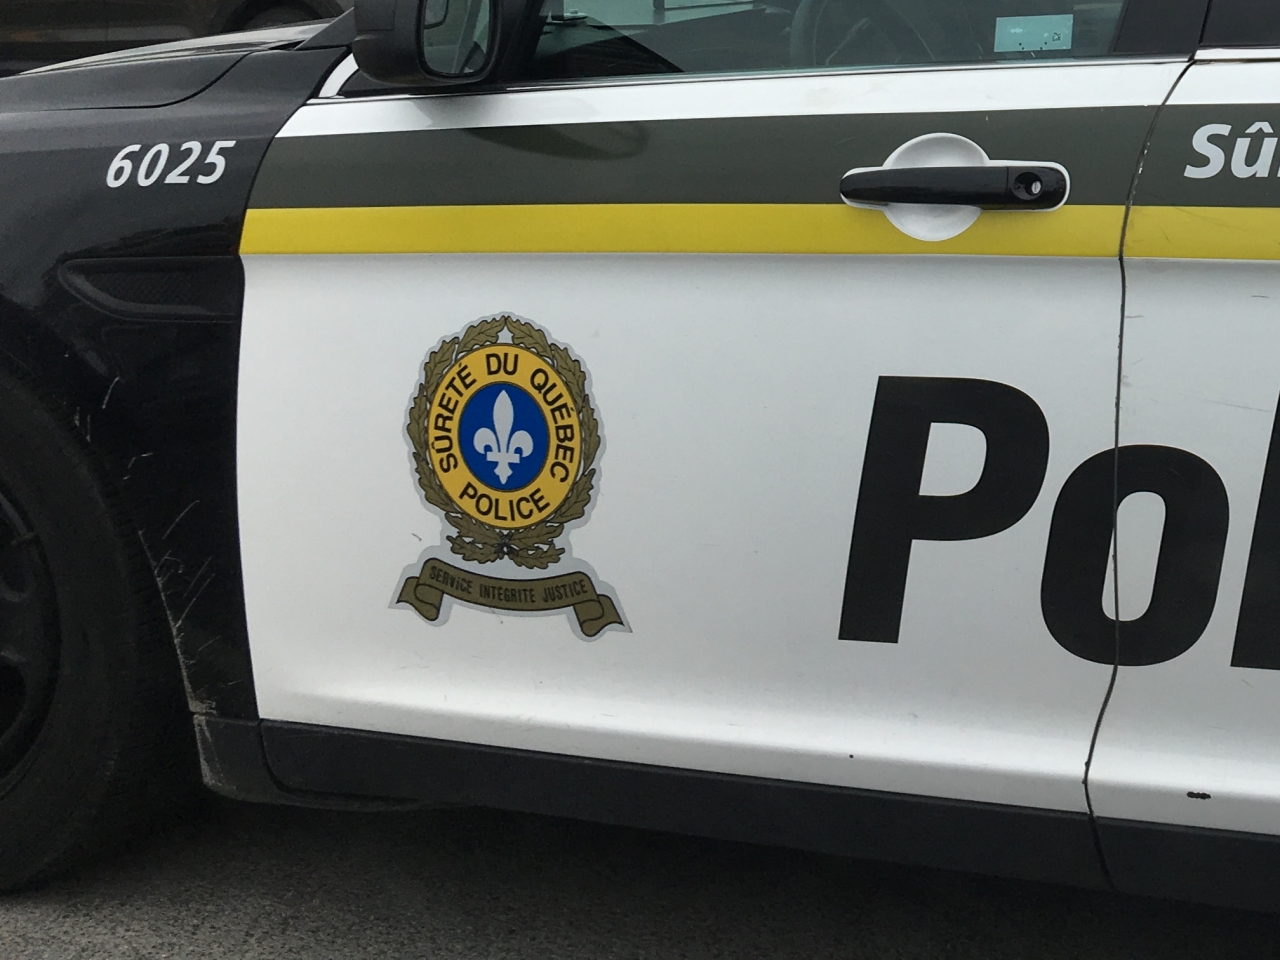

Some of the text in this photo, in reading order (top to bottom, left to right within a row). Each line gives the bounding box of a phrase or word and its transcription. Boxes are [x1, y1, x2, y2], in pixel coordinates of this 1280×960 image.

[106, 140, 237, 188] 6025
[431, 352, 576, 483] SÛRETÉ DU QUÉBEC
[458, 482, 551, 521] POLICE
[543, 579, 588, 602] JUSTICE
